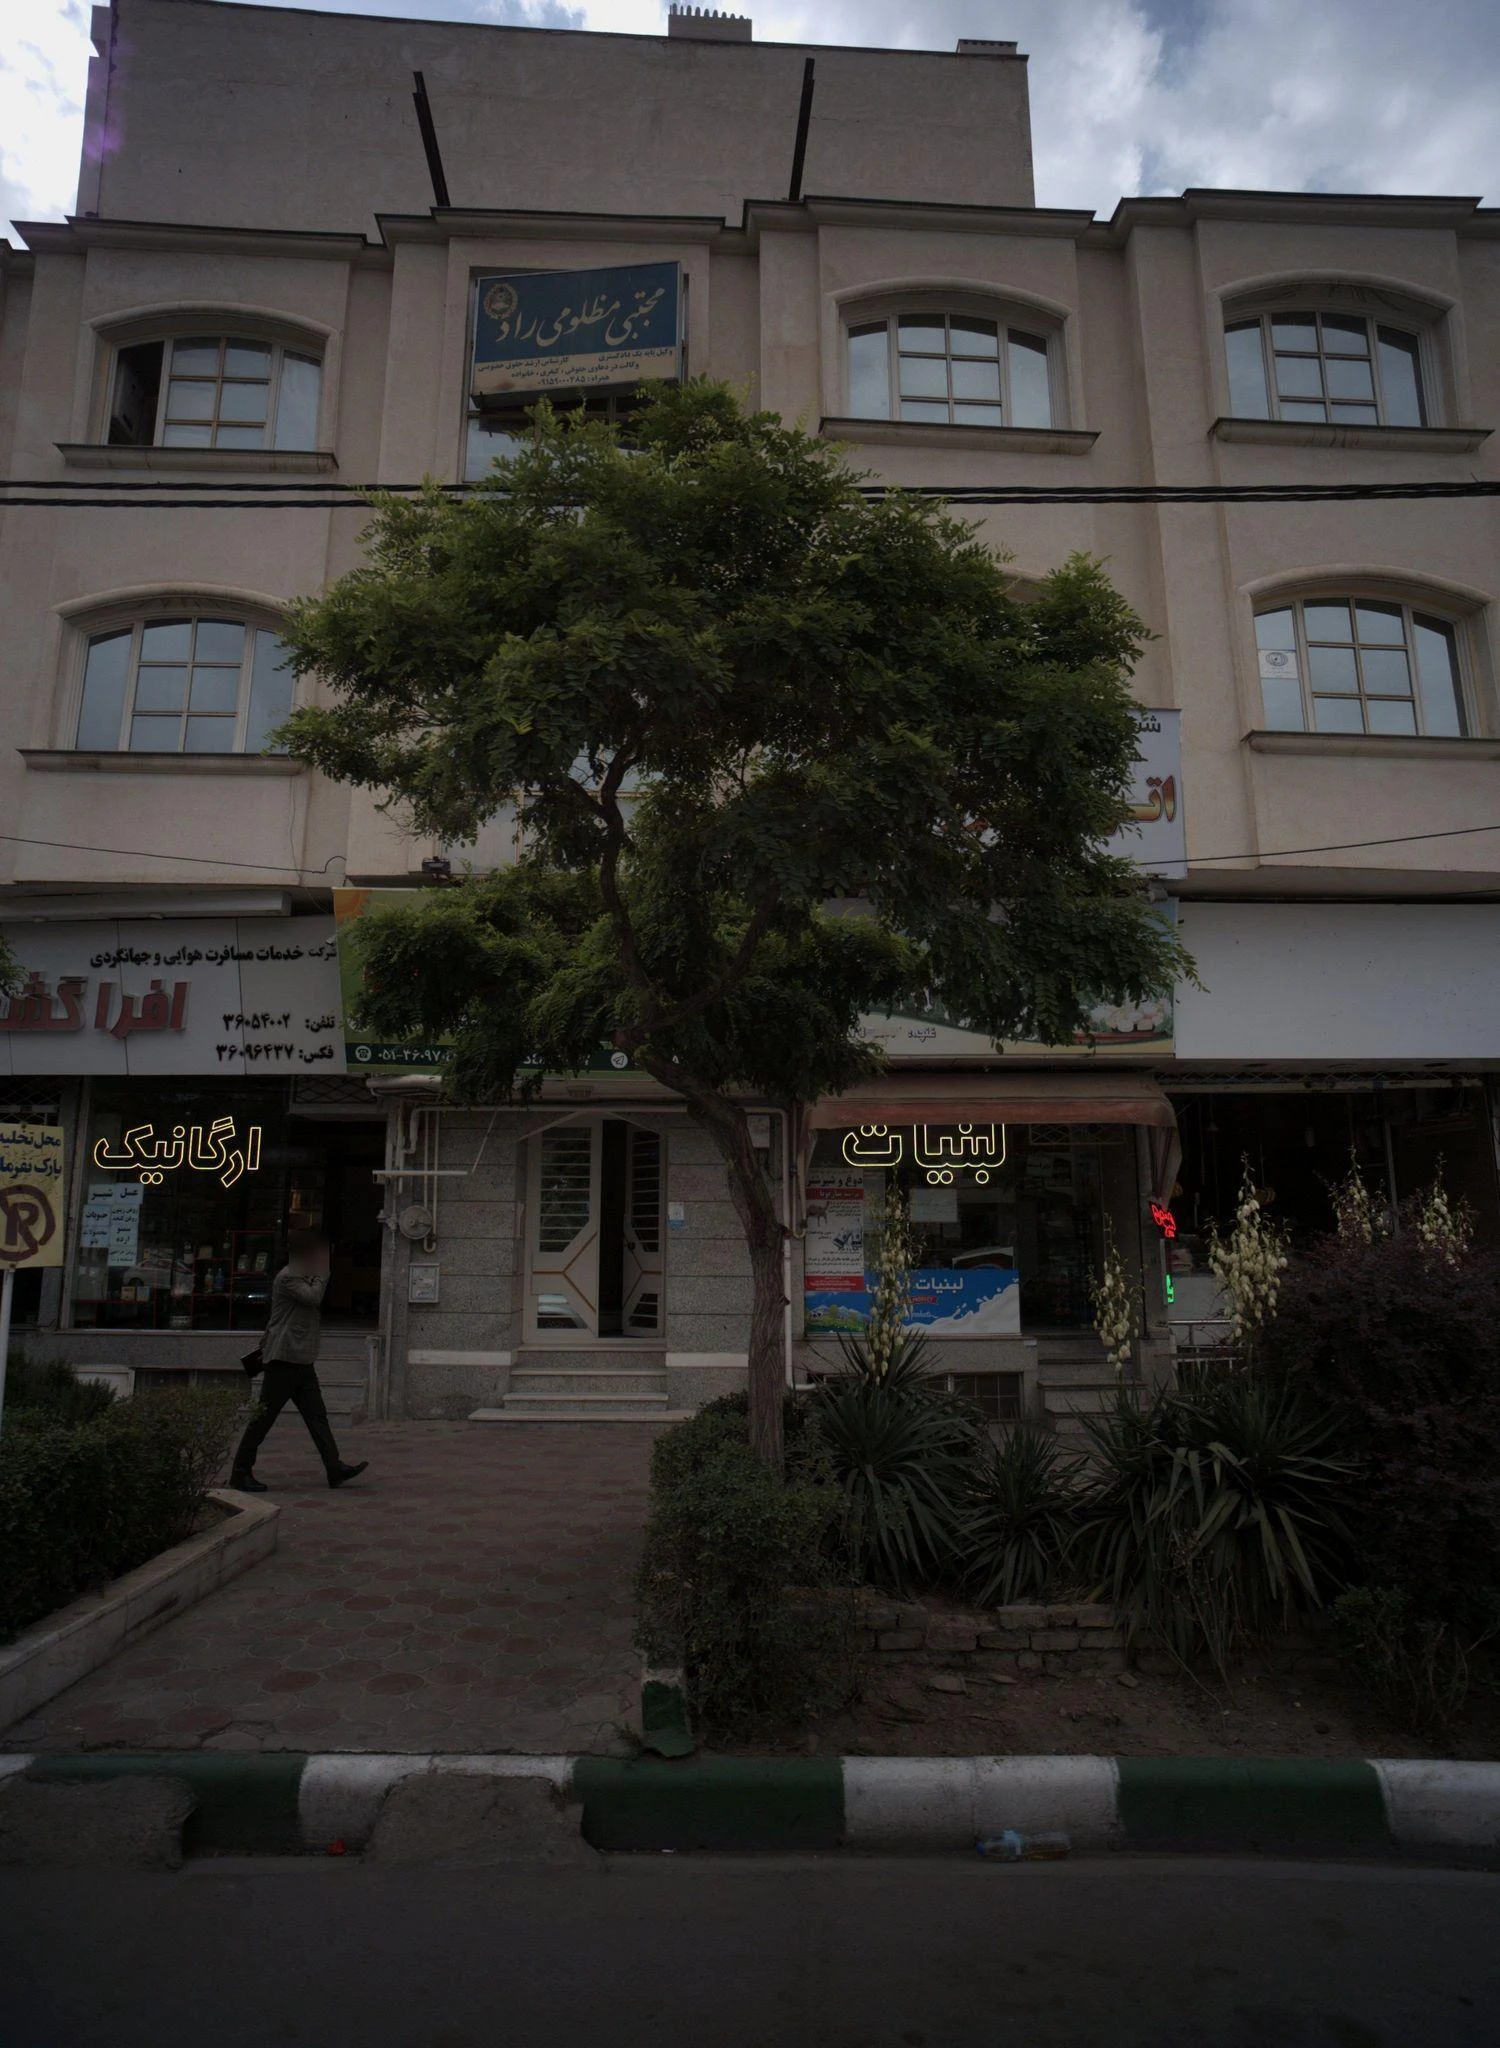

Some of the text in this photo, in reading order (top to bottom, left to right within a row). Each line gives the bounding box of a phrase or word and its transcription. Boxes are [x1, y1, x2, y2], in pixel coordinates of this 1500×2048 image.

[495, 288, 666, 347] مجتبی مظلومی راد
[90, 941, 337, 968] شرکت خدمات مسافرت هوایی و جهانگردی
[94, 979, 188, 1040] افرا
[34, 1132, 61, 1149] محل
[94, 1116, 262, 1188] ارگانیک
[842, 1123, 1006, 1184] لبنیات
[915, 1277, 964, 1294] لبنیات
